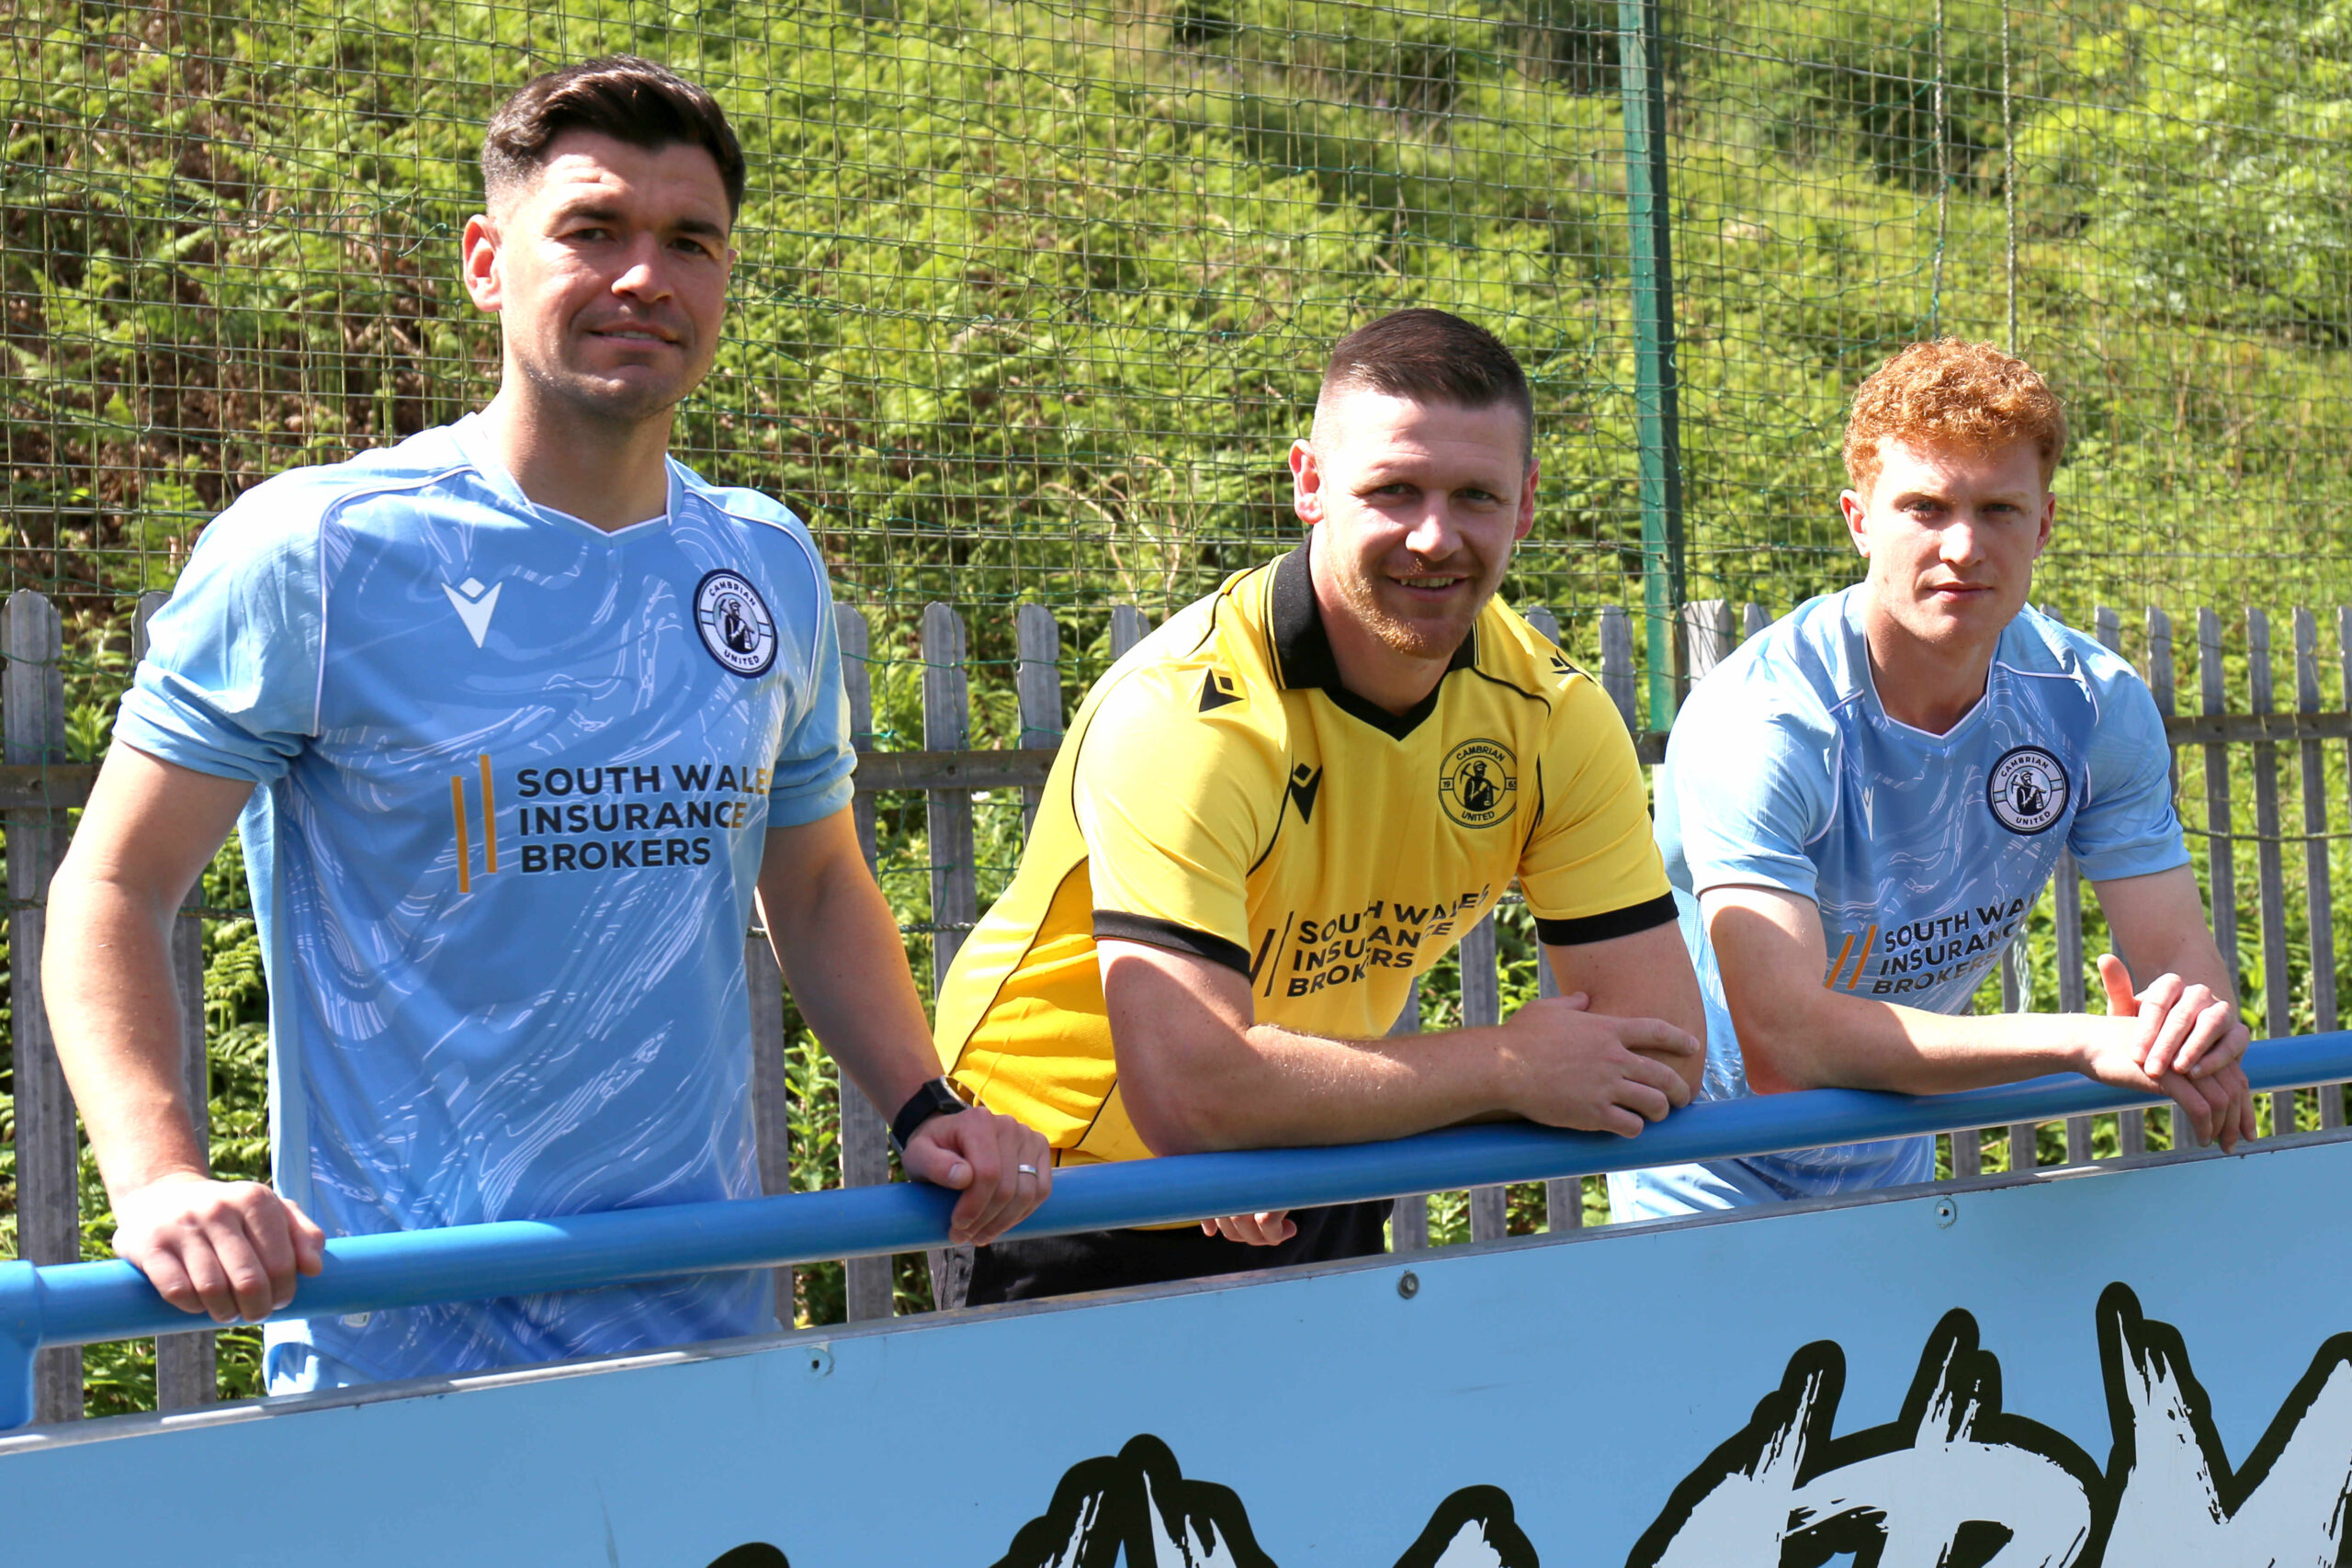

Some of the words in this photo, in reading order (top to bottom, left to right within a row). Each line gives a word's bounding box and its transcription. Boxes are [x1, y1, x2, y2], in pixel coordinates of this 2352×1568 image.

[708, 581, 756, 606] CAMBRIAN
[724, 649, 760, 666] UNITED
[1456, 746, 1505, 761] CAMBRIAN
[2001, 756, 2049, 777] CAMBRIAN
[516, 765, 662, 797] SOUTH
[672, 764, 772, 795] WALE
[519, 801, 747, 836] INSURANCE
[1462, 810, 1495, 821] UNITED
[2016, 811, 2051, 825] UNITED
[521, 837, 711, 874] BROKERS
[1298, 900, 1384, 944] SOUH
[1884, 910, 1970, 953] SOUTH
[1293, 922, 1454, 971] INSUANCE
[1287, 947, 1415, 998] BROKRS
